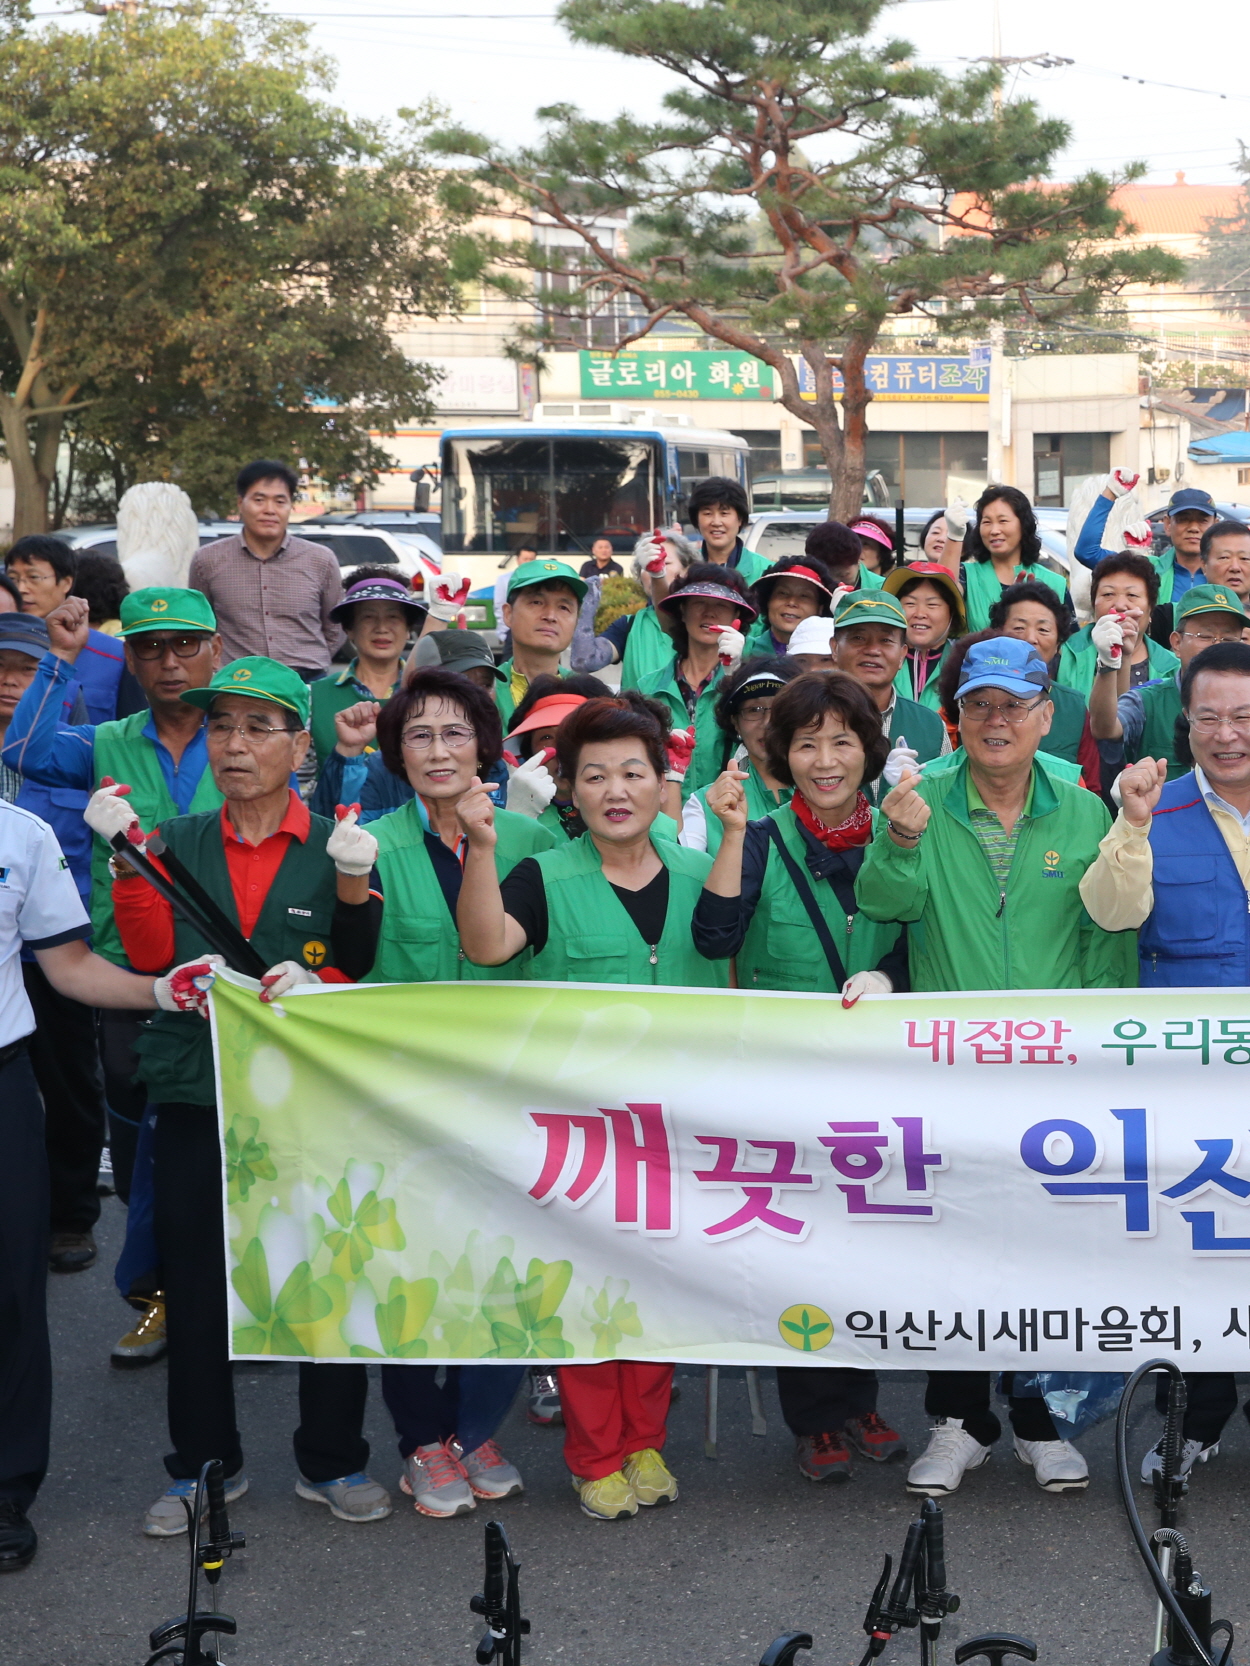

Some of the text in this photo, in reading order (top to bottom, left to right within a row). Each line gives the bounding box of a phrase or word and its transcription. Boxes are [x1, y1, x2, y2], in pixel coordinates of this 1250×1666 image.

[588, 359, 761, 389] 글로리아 화원
[653, 389, 699, 399] 855-0430
[1041, 870, 1064, 879] SMU
[904, 1019, 1078, 1066] 내집앞,
[529, 1103, 943, 1237] 깨끗한
[845, 1306, 1203, 1353] 익산시새마을회,
